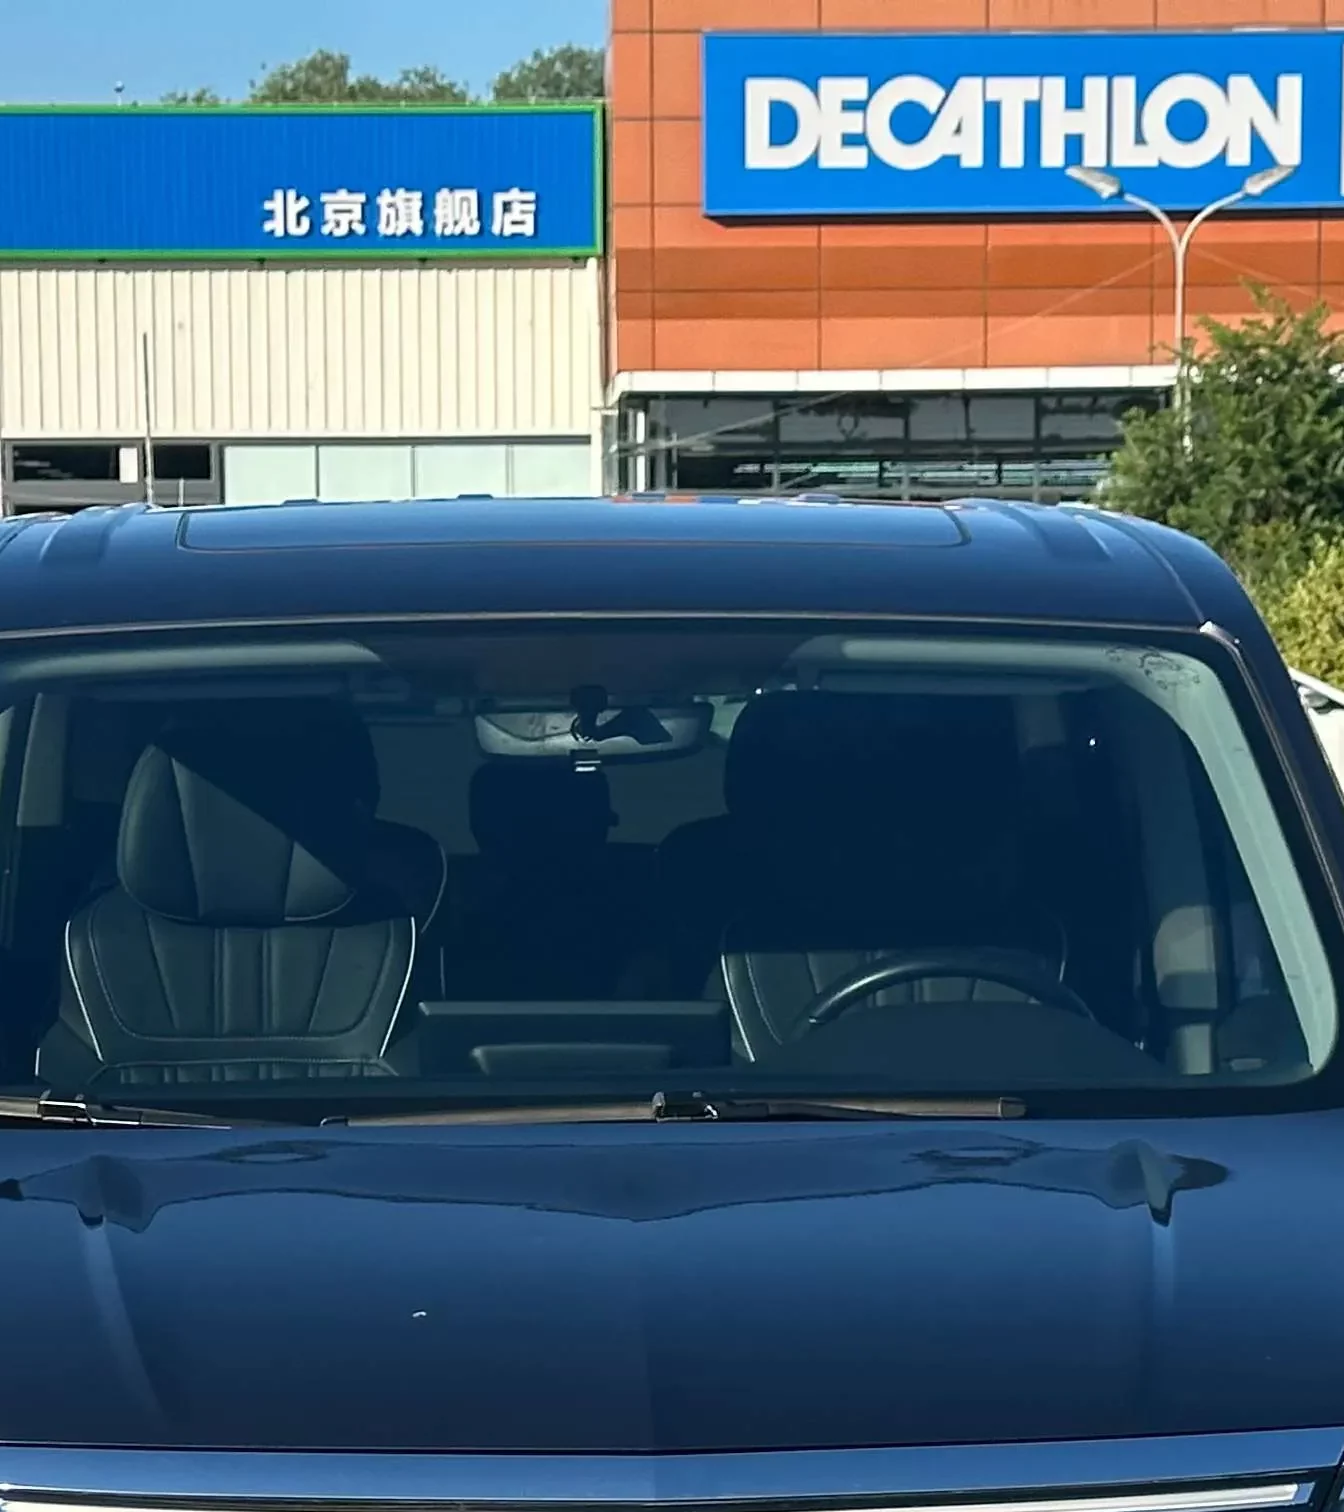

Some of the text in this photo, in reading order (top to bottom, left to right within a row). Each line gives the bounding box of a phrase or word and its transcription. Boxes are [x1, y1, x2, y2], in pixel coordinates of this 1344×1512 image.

[744, 73, 1303, 170] DECATHLON
[262, 187, 537, 238] 北京旗舰店
